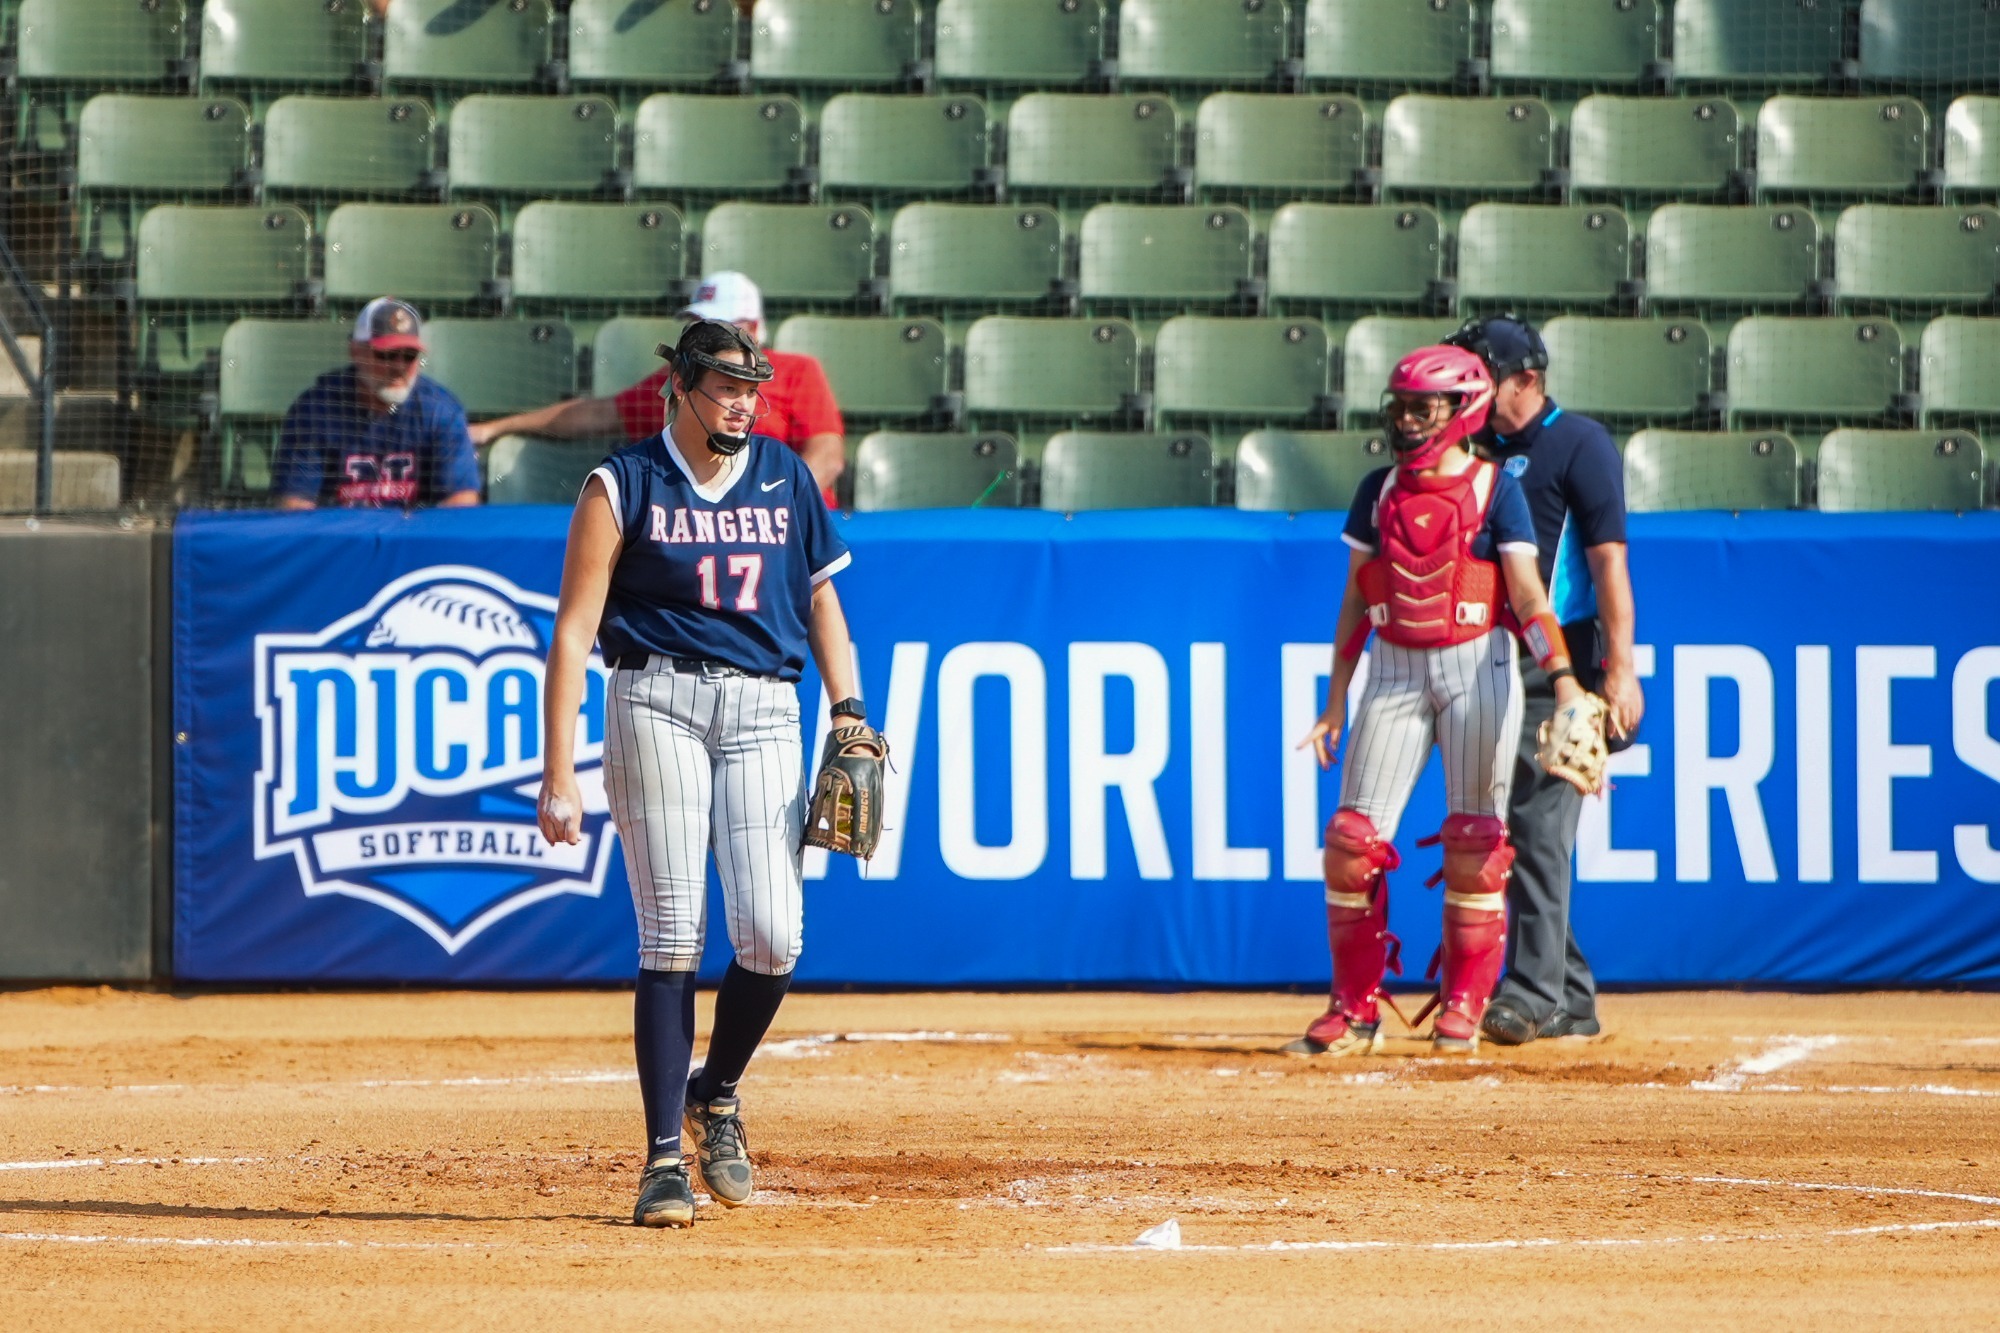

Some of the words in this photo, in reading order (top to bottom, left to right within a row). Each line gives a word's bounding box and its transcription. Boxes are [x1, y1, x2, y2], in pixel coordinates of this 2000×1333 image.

[650, 504, 789, 545] RANGERS
[696, 553, 763, 611] 17
[360, 830, 544, 858] SOFTBALL
